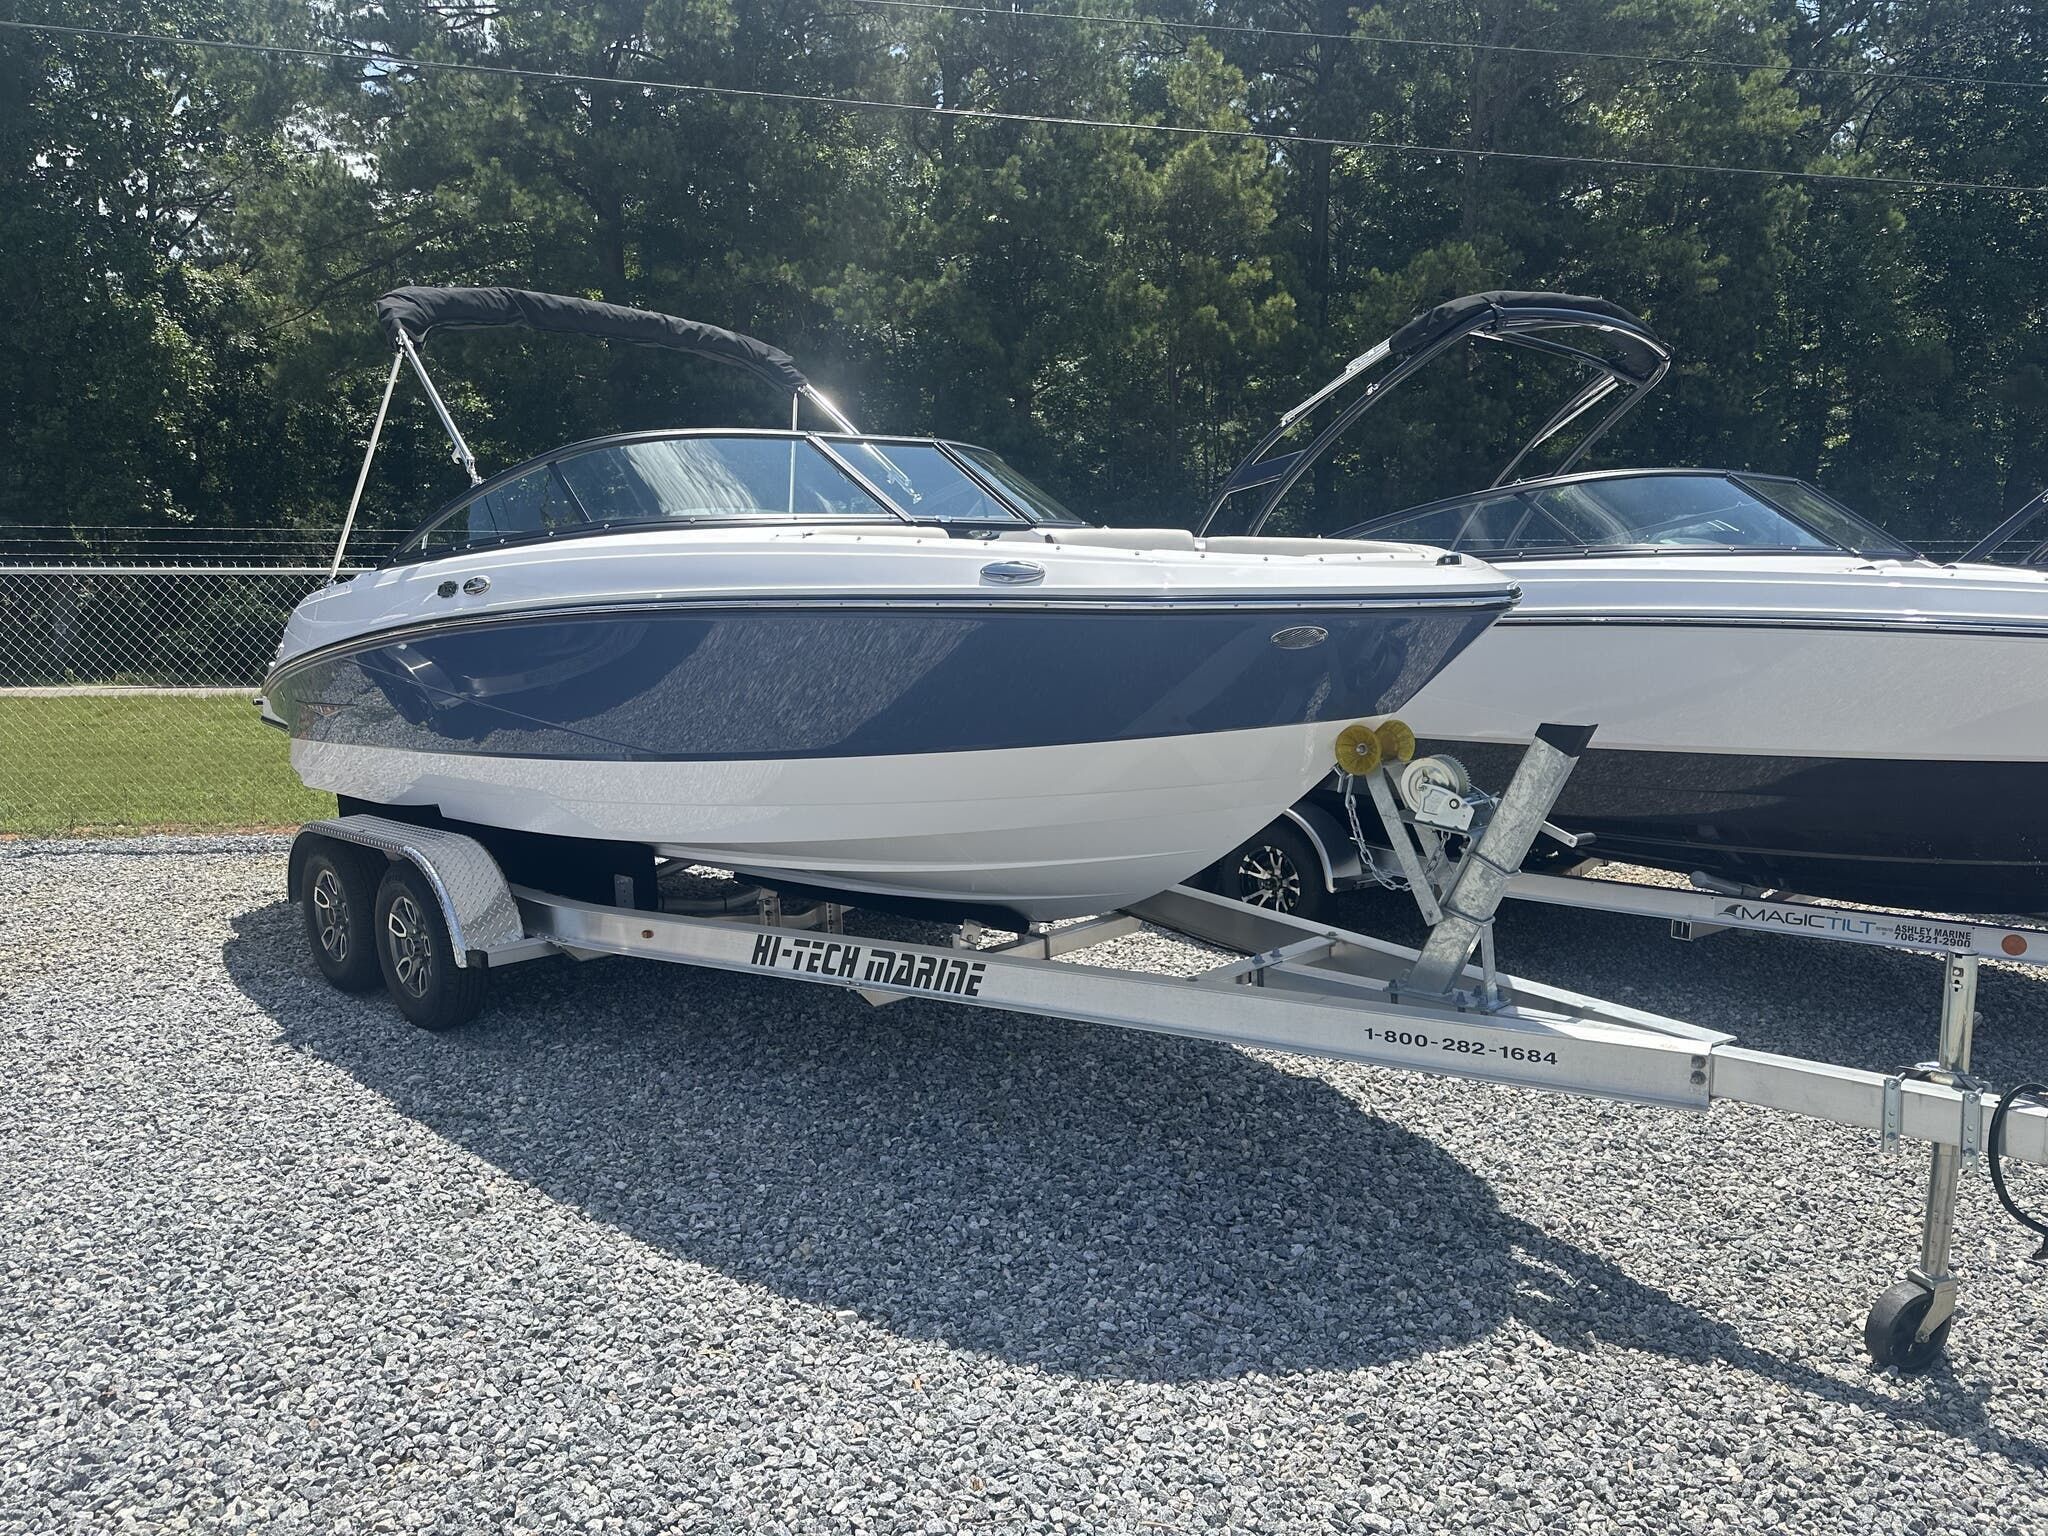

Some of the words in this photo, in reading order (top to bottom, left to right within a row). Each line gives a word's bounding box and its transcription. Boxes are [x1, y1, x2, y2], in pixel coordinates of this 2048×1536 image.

[1742, 906, 1877, 934] MAGICTILT
[1894, 924, 1932, 936] ASHLEY
[1934, 928, 1972, 941] MARINE
[1894, 932, 1971, 948] 706-221-2900
[751, 933, 861, 979] HI-TECH
[864, 949, 987, 997] MARINE
[1364, 1027, 1558, 1065] 1-800-282-1684
